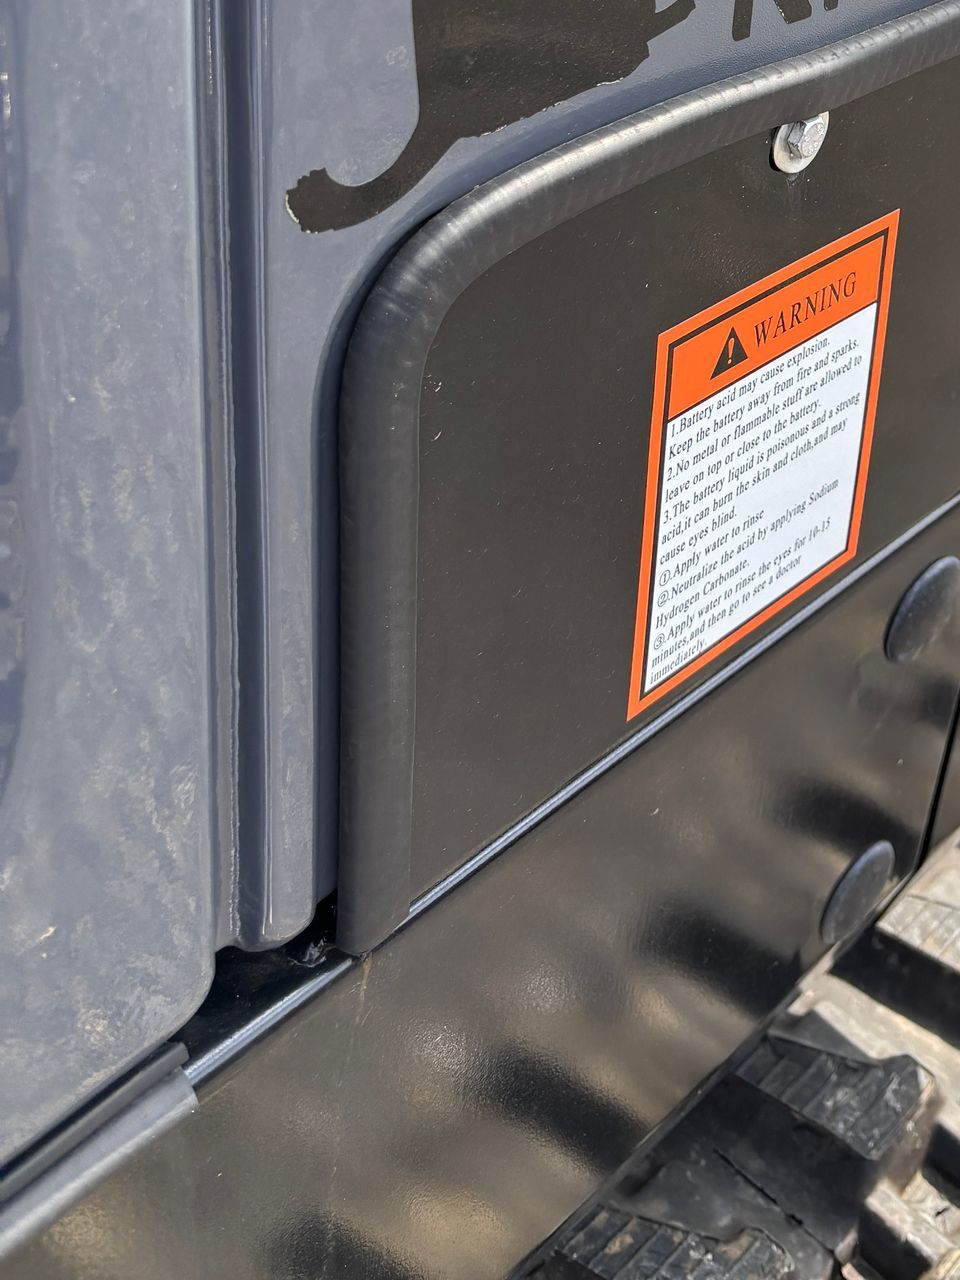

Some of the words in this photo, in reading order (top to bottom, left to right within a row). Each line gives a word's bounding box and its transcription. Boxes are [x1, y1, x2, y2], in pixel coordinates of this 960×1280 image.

[754, 271, 856, 347] WARNING
[666, 459, 689, 481] 2.No
[692, 438, 718, 465] metal
[720, 433, 731, 447] or
[733, 403, 779, 439] flammable
[781, 386, 804, 410] stuff
[804, 381, 817, 396] are
[819, 357, 852, 387] allowed
[853, 355, 862, 366] to
[668, 437, 692, 459] Keep
[696, 426, 710, 443] the
[713, 405, 744, 432] battery
[747, 390, 770, 411] away
[773, 376, 793, 396] from
[796, 366, 811, 382] fire
[813, 352, 829, 371] and
[830, 339, 858, 363] sparks.
[671, 403, 713, 437] 1.Battery
[716, 387, 736, 409] acid
[738, 378, 757, 397] may
[760, 362, 784, 383] cause
[786, 337, 829, 368] explosion.
[661, 516, 691, 544] acid,it
[693, 506, 709, 523] can
[712, 491, 732, 511] burn
[735, 480, 749, 496] the
[751, 466, 770, 486] skin
[772, 452, 788, 472] and
[790, 426, 828, 461] cloth,and
[830, 417, 847, 435] may
[663, 499, 690, 524] 3.The
[693, 477, 725, 504] battery
[727, 455, 754, 482] liquid
[756, 451, 764, 464] is
[766, 424, 809, 461] poisonous
[811, 410, 826, 429] and
[835, 392, 860, 414] strong
[665, 480, 690, 502] leave
[692, 471, 704, 484] on
[707, 459, 721, 476] top
[724, 451, 734, 464] or
[736, 435, 760, 457] close
[762, 429, 771, 441] to
[773, 419, 787, 434] the
[789, 399, 820, 424] battery.
[659, 541, 685, 565] cause
[688, 526, 708, 546] eyes
[711, 505, 736, 531] blind.
[697, 595, 721, 618] water
[724, 588, 732, 600] to
[734, 571, 756, 592] rinse
[758, 561, 771, 576] the
[773, 546, 791, 565] eyes
[793, 536, 806, 551] for
[808, 516, 830, 541] 10-15
[704, 532, 729, 555] water
[731, 525, 740, 538] to
[742, 509, 764, 530] rinse
[720, 549, 734, 565] the
[736, 531, 755, 554] acid
[757, 526, 768, 540] by
[770, 500, 806, 531] applying
[808, 479, 838, 505] Sodium
[655, 591, 699, 629] Hydrogen
[707, 608, 726, 627] then
[728, 599, 739, 615] go
[741, 591, 750, 603] to
[752, 580, 766, 596] see
[775, 555, 801, 579] doctor
